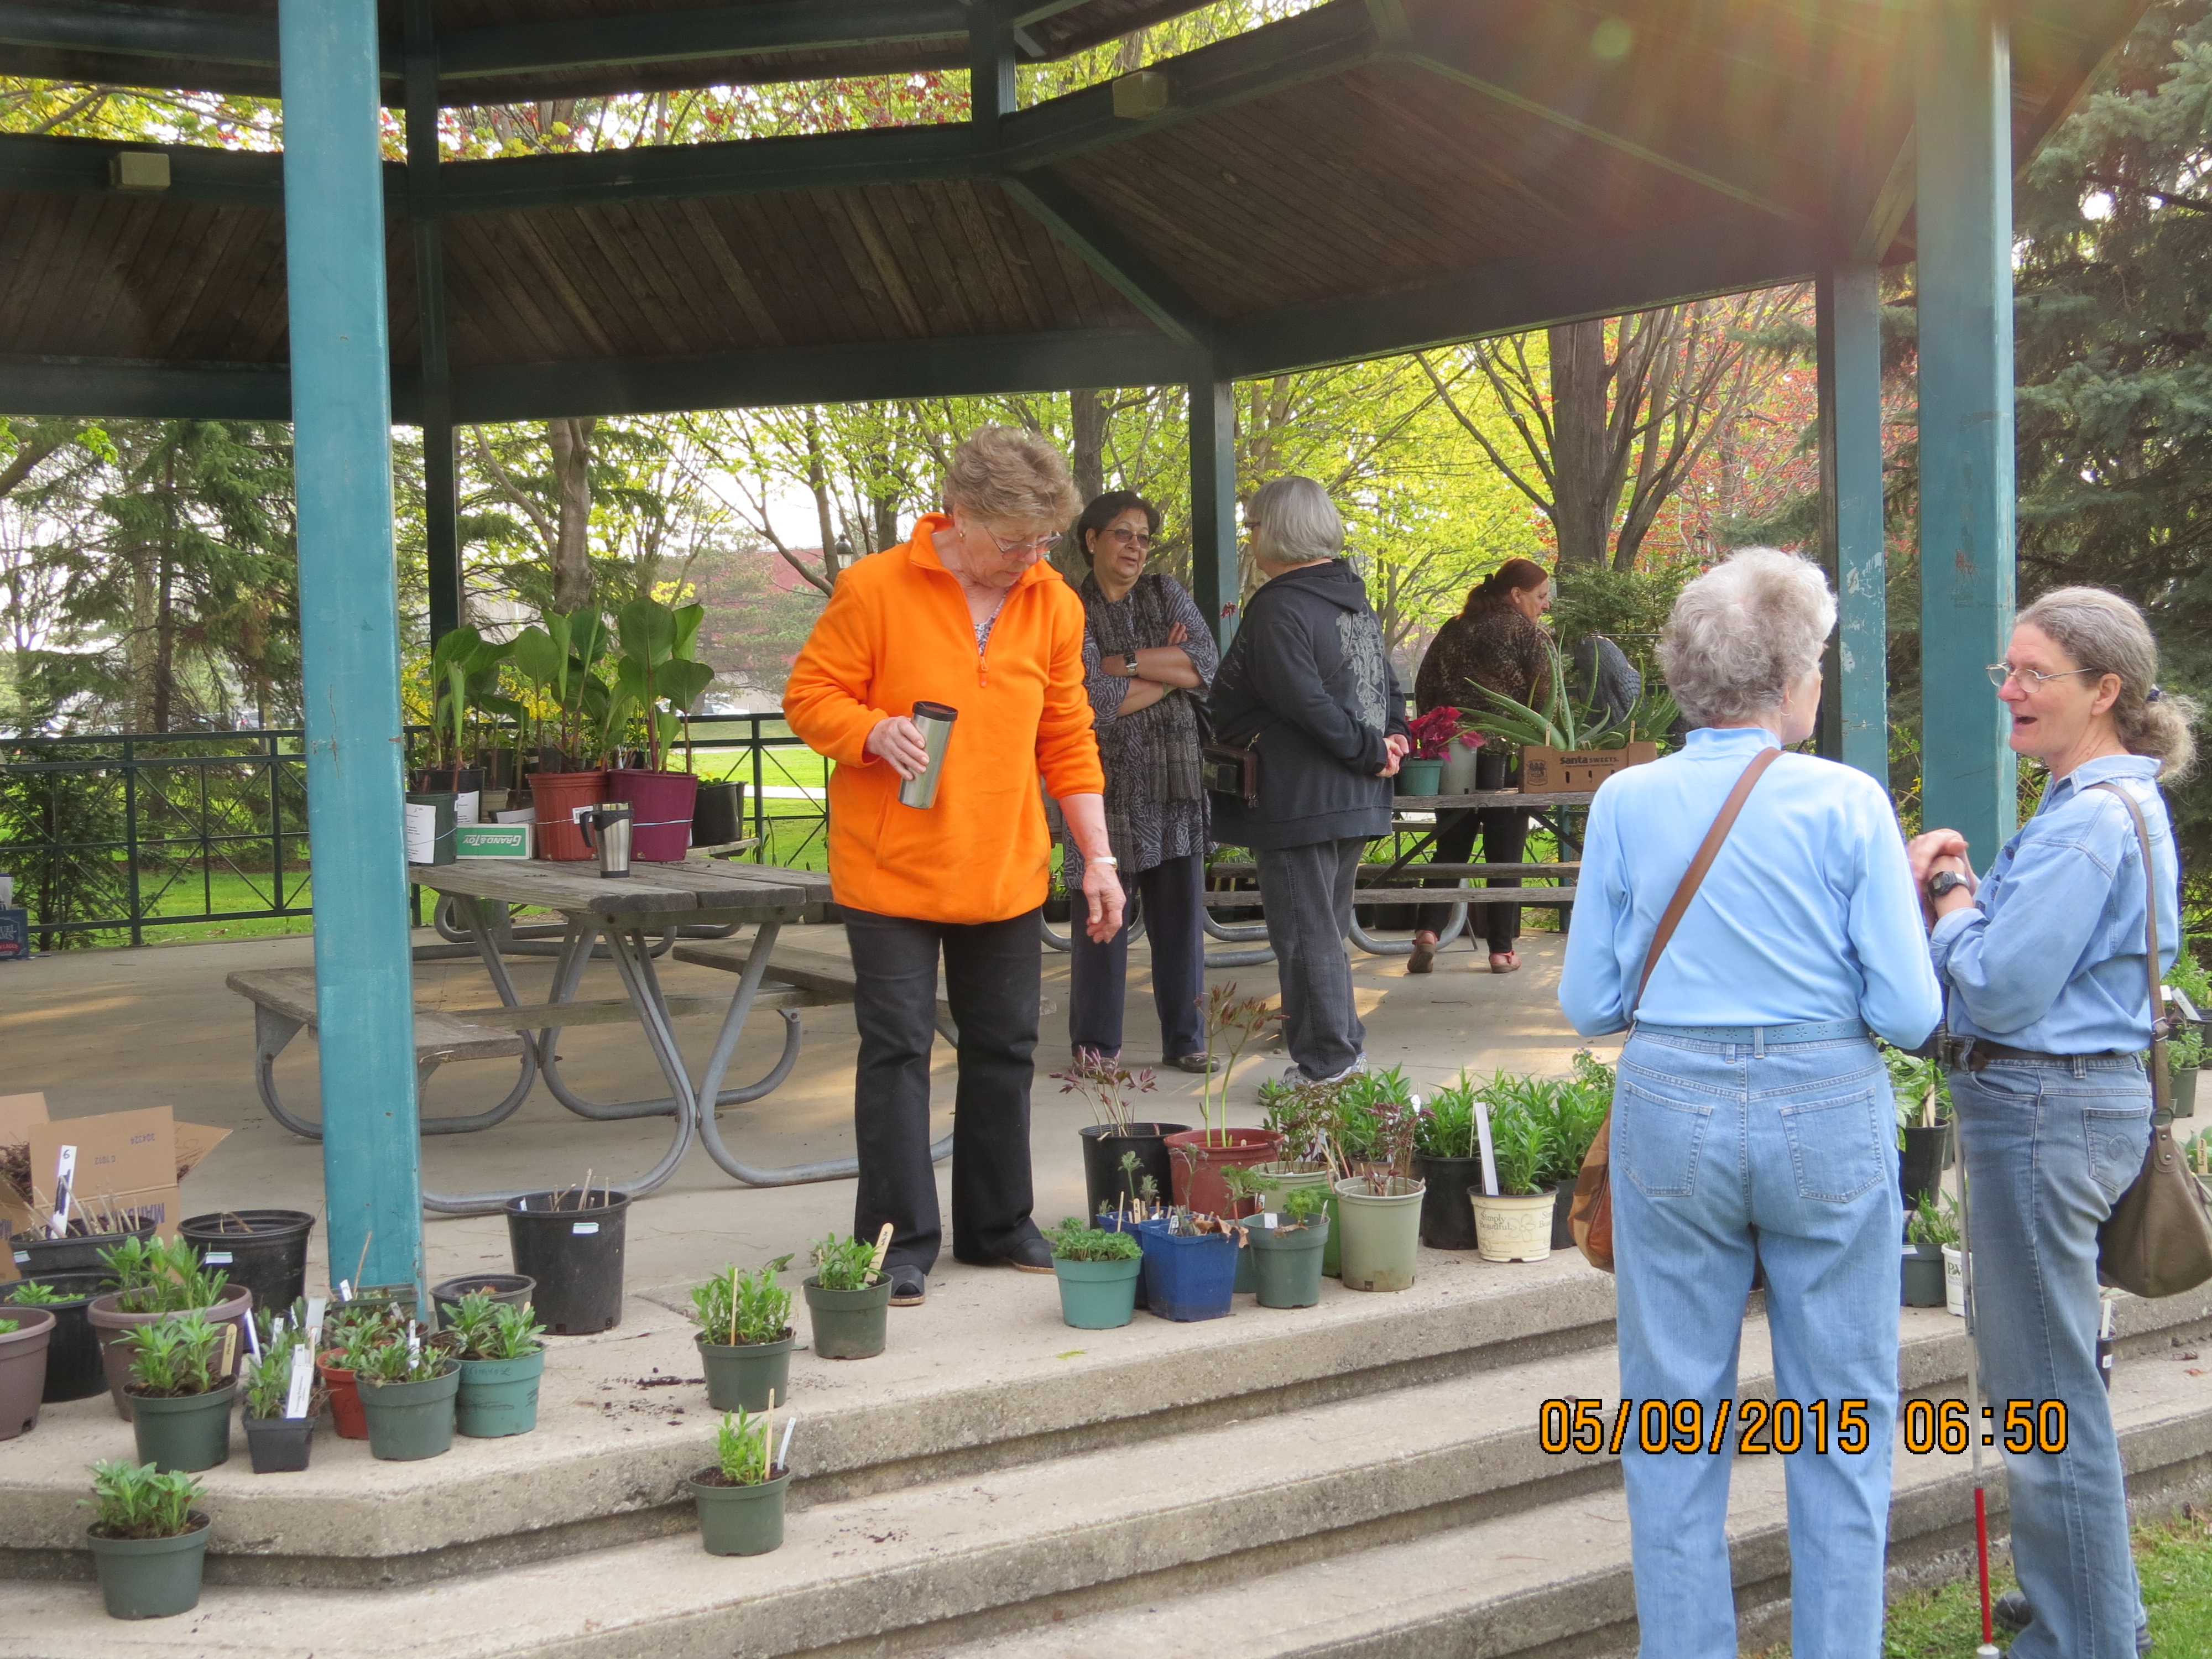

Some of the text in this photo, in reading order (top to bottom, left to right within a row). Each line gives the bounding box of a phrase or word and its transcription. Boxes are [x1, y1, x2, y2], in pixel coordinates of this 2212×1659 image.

[462, 834, 522, 847] GRAND&TOY
[0, 924, 17, 933] UEL
[1480, 1209, 1506, 1223] Simply
